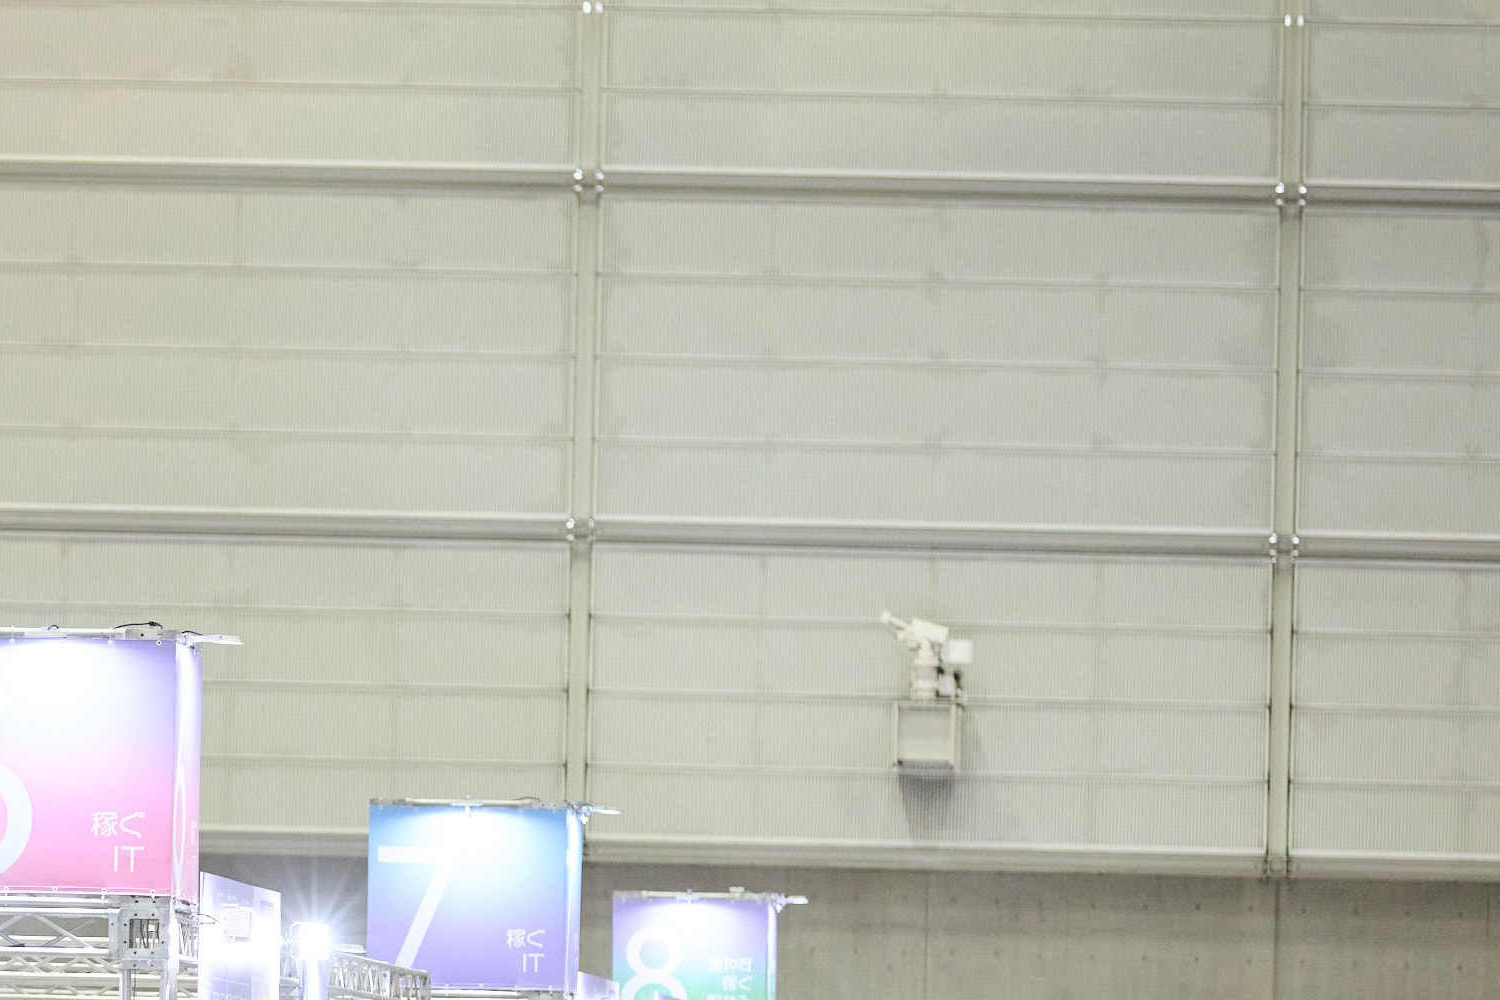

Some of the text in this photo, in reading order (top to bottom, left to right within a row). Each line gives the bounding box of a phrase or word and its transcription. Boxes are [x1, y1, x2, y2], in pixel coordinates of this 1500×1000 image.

[90, 810, 146, 839] 稼ぐ
[113, 846, 145, 873] IT
[376, 845, 458, 969] 7
[506, 928, 546, 949] 稼ぐ
[522, 953, 546, 974] IT
